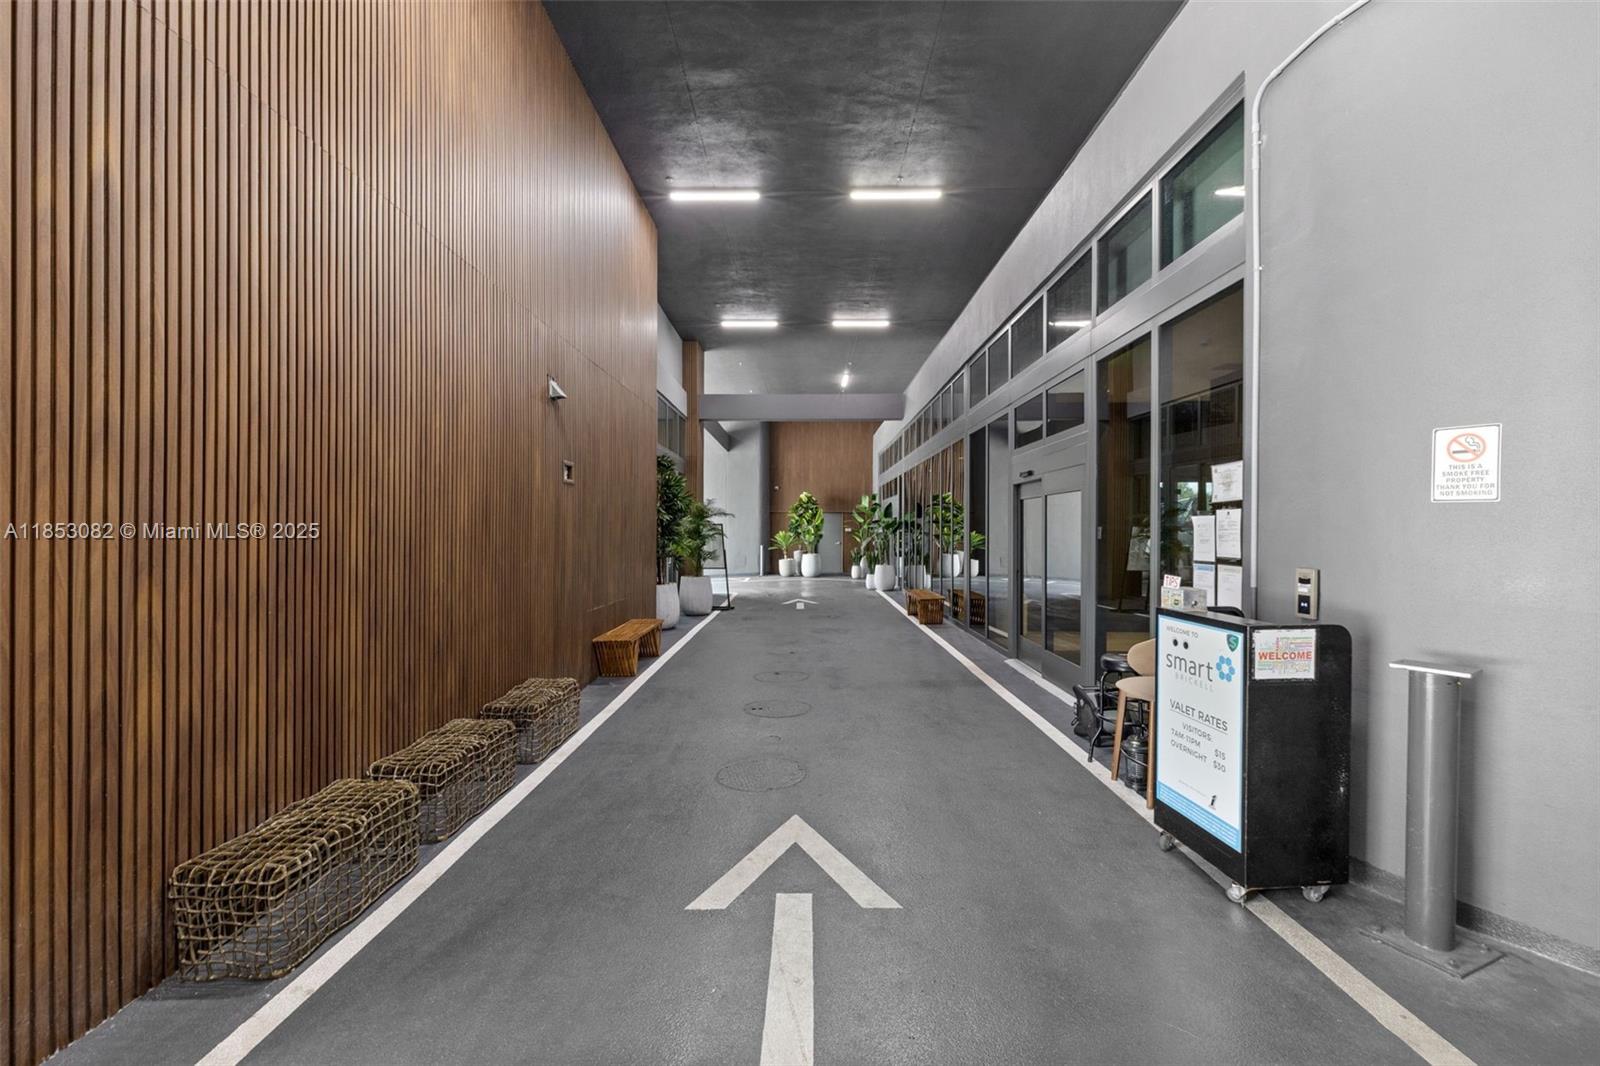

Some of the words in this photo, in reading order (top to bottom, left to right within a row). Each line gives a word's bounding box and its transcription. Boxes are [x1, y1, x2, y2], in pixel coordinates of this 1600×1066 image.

[1165, 575, 1179, 588] TIPS
[1166, 626, 1190, 637] WELCOME
[1191, 631, 1199, 639] TO
[1258, 651, 1312, 660] WELCOME
[1166, 653, 1214, 682] smart
[1170, 699, 1195, 717] VALET
[1198, 711, 1228, 732] RATES
[1170, 739, 1208, 763] OVERNIGHT
[1213, 760, 1226, 773] $30
[1214, 749, 1226, 761] $15
